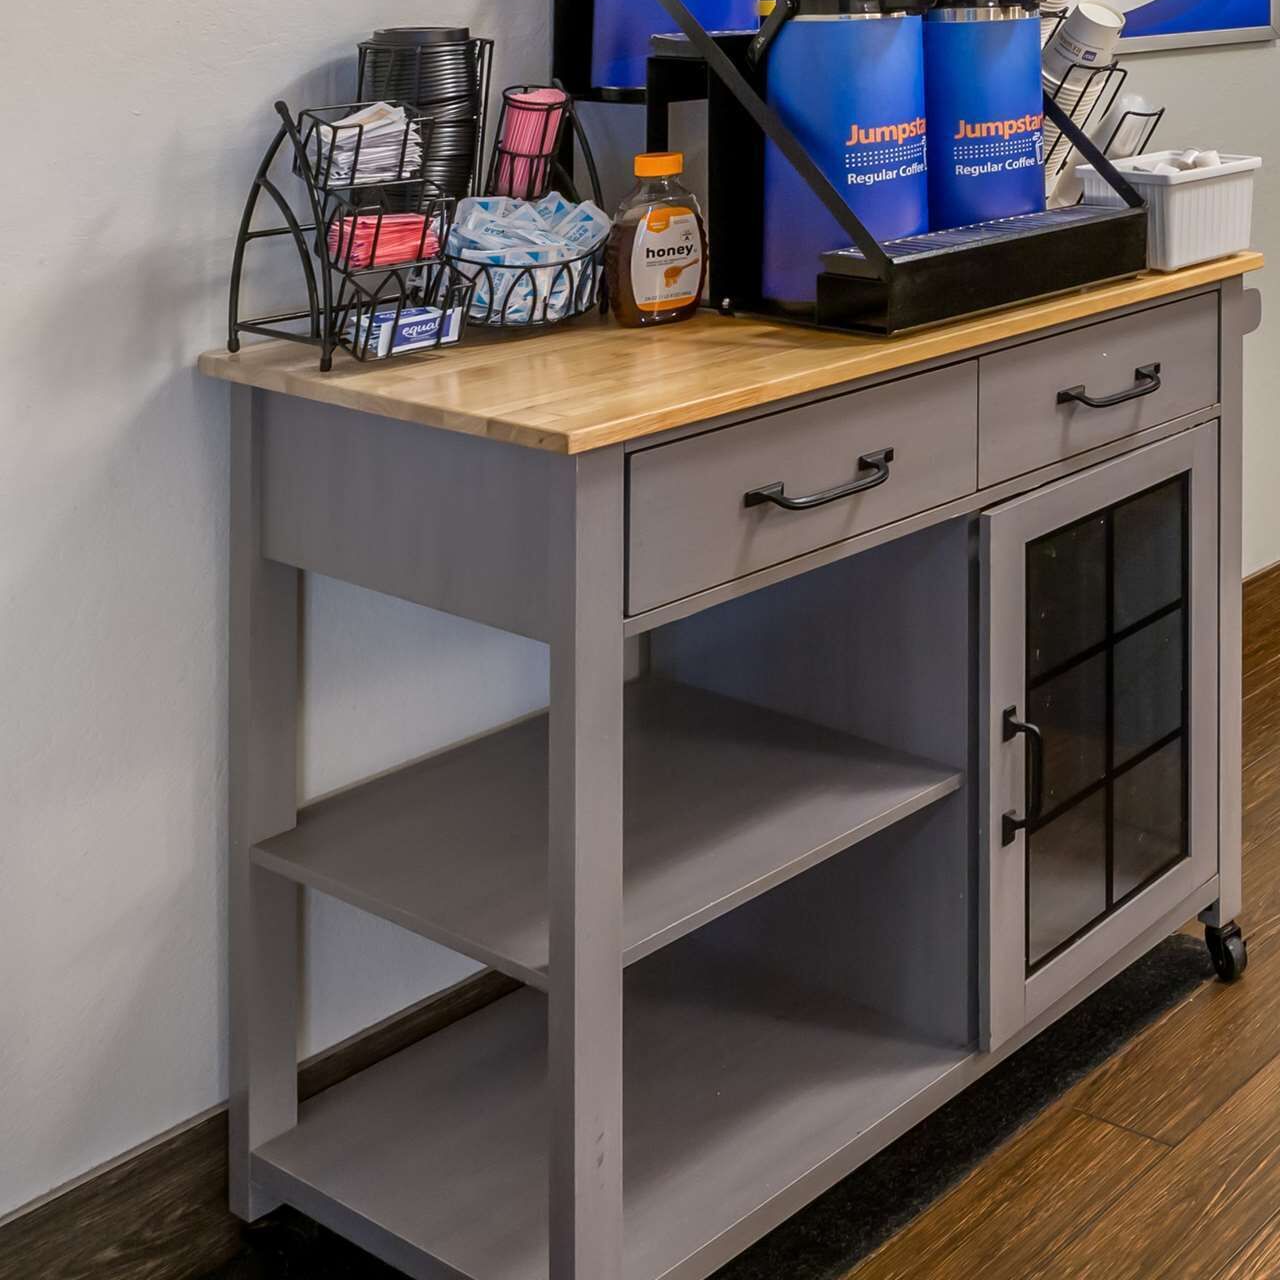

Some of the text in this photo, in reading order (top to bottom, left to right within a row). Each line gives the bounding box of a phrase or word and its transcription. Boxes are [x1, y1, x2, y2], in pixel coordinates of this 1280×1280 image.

[845, 117, 926, 147] Jumpsta
[954, 111, 1045, 140] Jumpstar
[847, 161, 926, 186] Regular Coffee
[955, 156, 1036, 177] Regular Coffee
[646, 244, 694, 259] honey
[402, 318, 441, 337] equal
